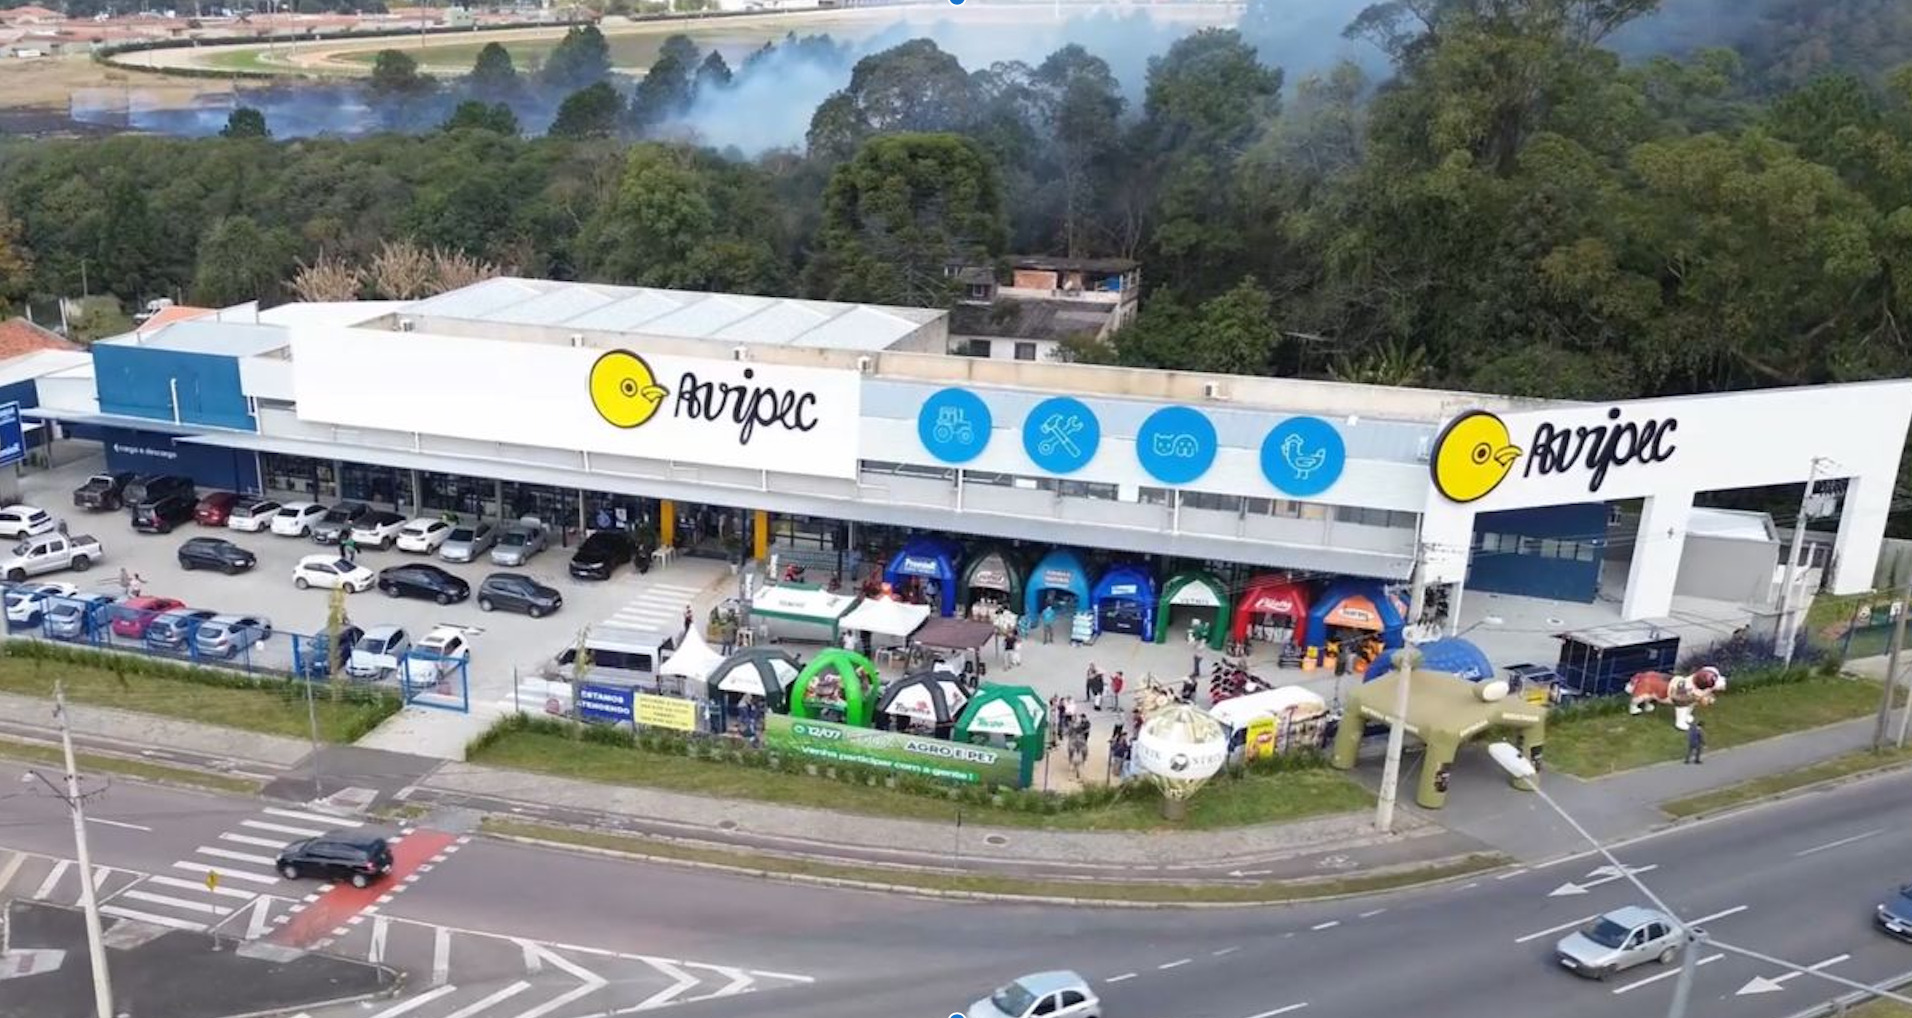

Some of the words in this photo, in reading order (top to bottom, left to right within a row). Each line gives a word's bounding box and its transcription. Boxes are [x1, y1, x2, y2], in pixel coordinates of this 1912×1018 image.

[674, 368, 818, 445] Avipec
[1523, 407, 1677, 492] Avipec
[581, 690, 624, 704] ESTAMOS
[807, 726, 841, 739] 12/07
[801, 746, 837, 757] Venha
[839, 754, 892, 767] participar
[894, 763, 922, 772] com
[932, 769, 968, 780] gente
[906, 742, 952, 757] AGRO
[954, 748, 965, 758] E
[967, 750, 997, 764] PET
